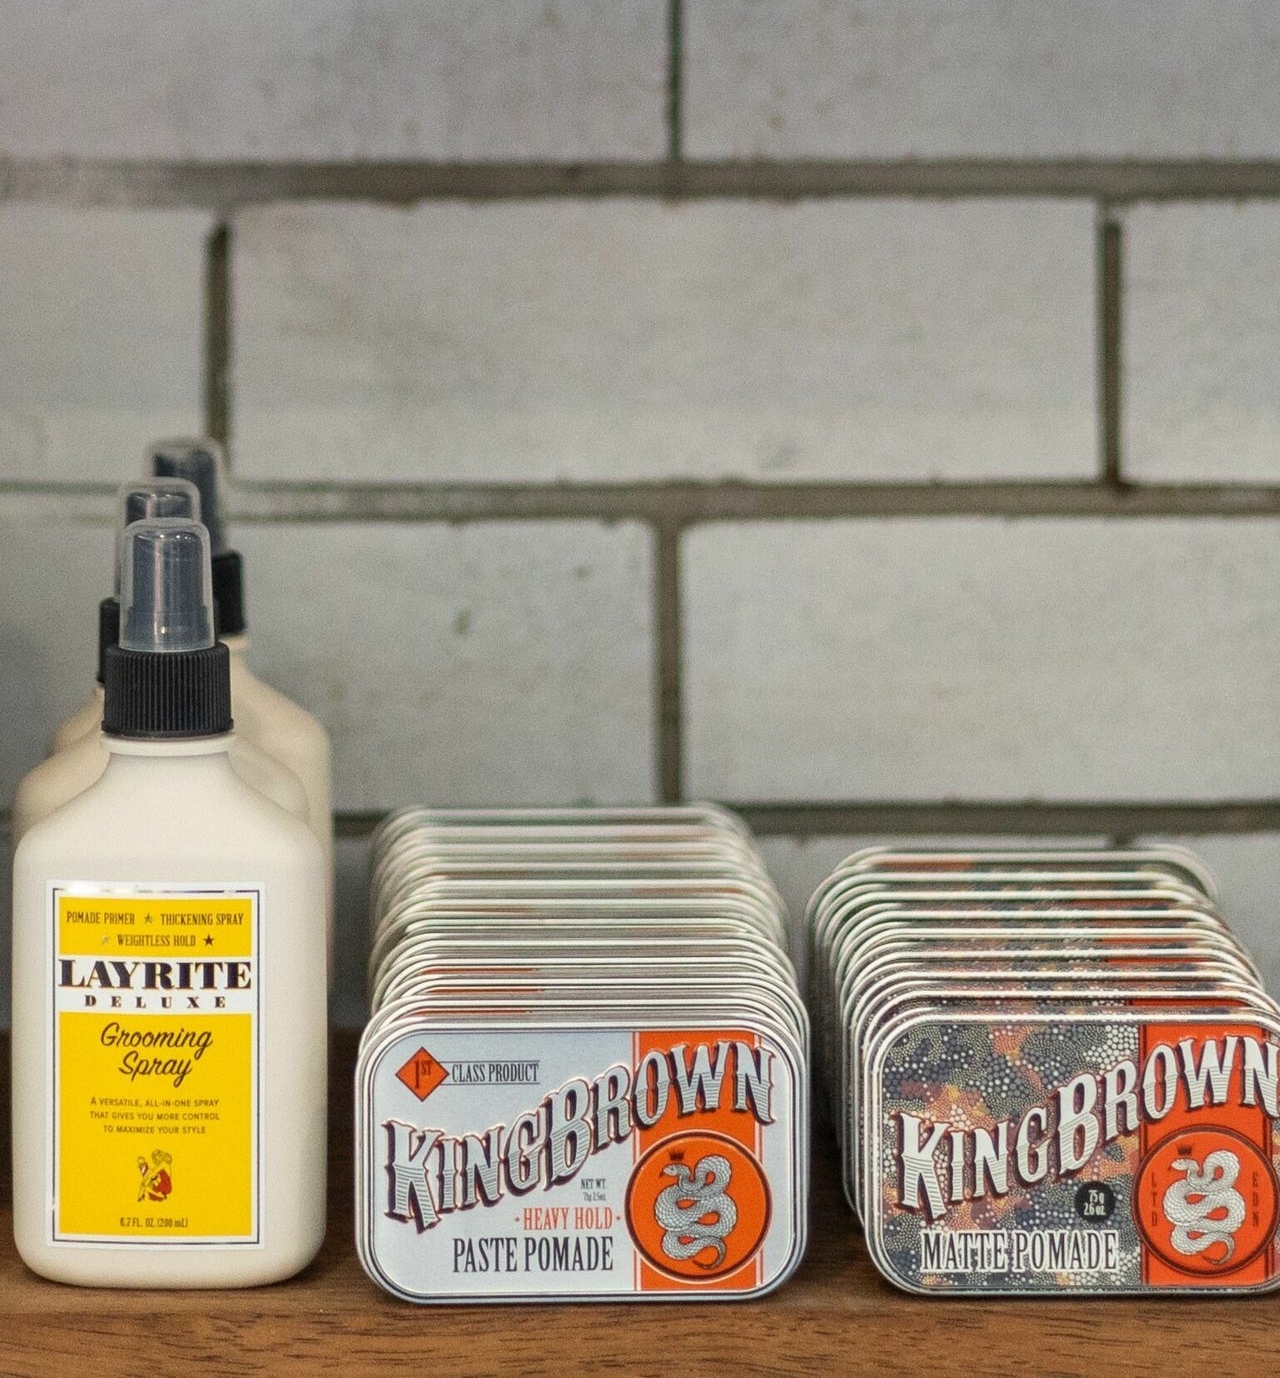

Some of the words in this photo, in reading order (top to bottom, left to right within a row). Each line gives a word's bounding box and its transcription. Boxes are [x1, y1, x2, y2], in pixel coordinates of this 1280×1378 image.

[67, 911, 100, 924] POMADE
[104, 913, 135, 924] PRIMER
[117, 934, 170, 947] WEIGHTLESS
[174, 935, 196, 947] HOLD
[58, 959, 252, 991] LAYRITE
[85, 995, 226, 1008] DELUXE
[101, 1022, 213, 1060] Grooming
[118, 1051, 192, 1087] Spray
[452, 1064, 486, 1082] CLASS
[489, 1064, 539, 1082] PRODUCT
[523, 1207, 570, 1230] HEAVY
[574, 1207, 613, 1230] HOLD
[453, 1238, 517, 1273] PASTE
[524, 1236, 613, 1271] POMADE
[922, 1230, 1006, 1271] MATTE
[1018, 1229, 1117, 1270] POMADE
